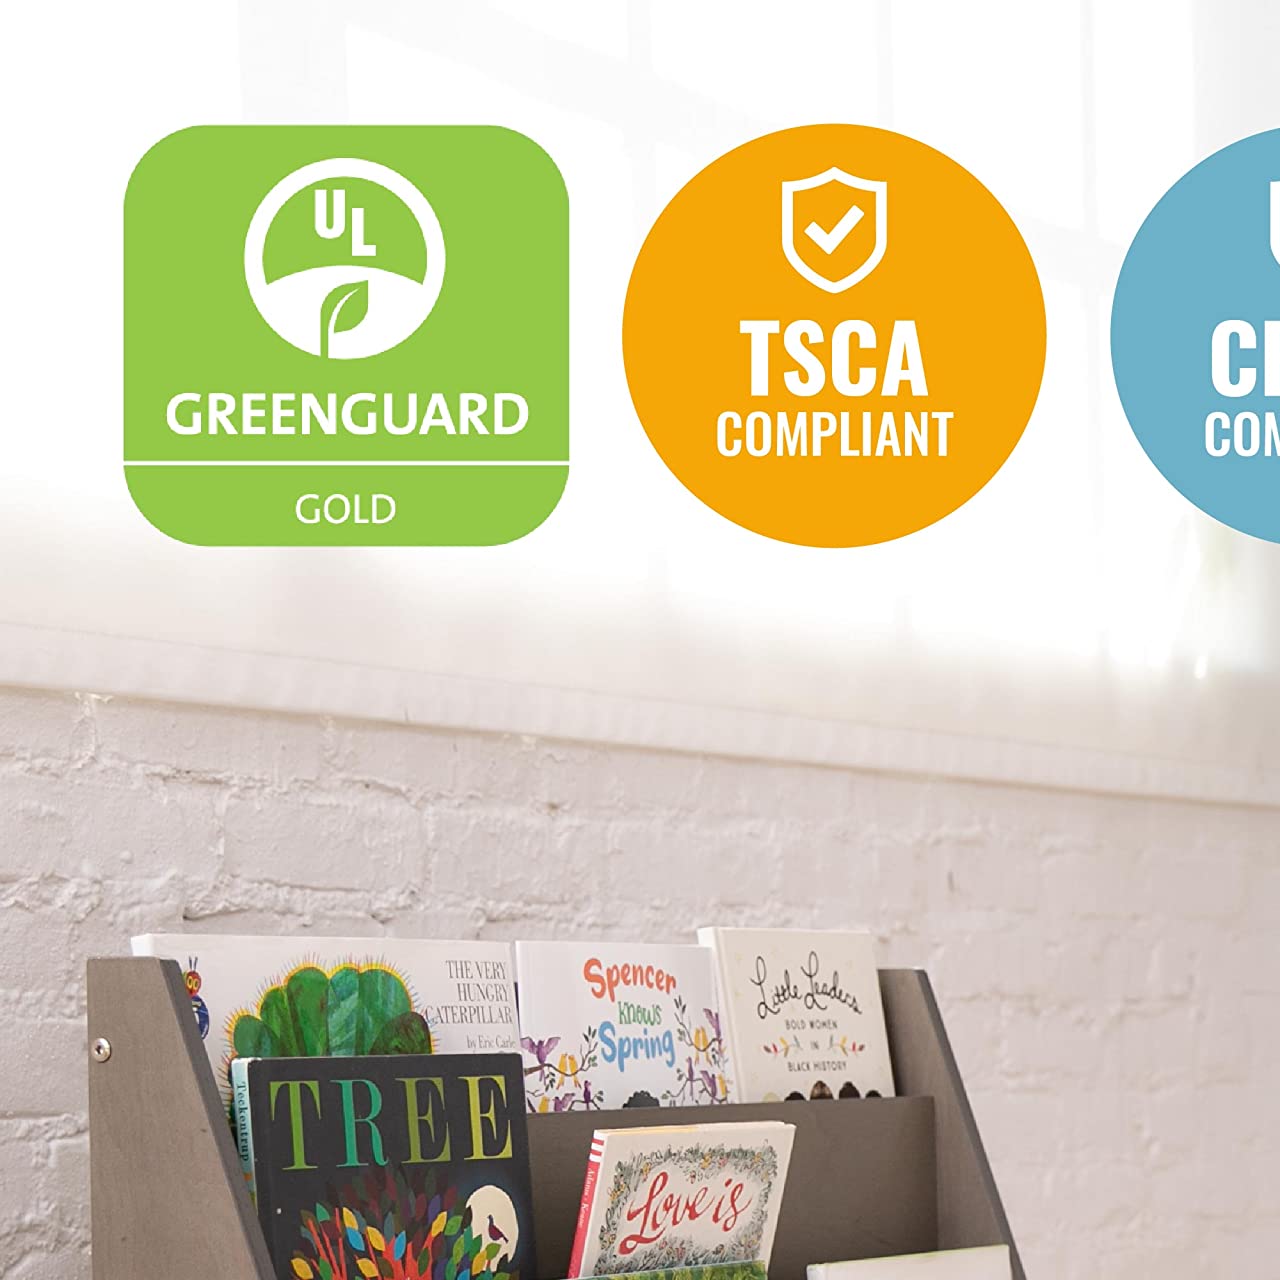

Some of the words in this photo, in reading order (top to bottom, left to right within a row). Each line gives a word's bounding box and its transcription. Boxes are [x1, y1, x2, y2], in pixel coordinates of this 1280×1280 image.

[446, 960, 473, 978] THE
[475, 961, 506, 980] VERY
[583, 958, 676, 1003] Spencer
[749, 955, 802, 1019] Little
[800, 950, 862, 1015] Leaders
[457, 983, 508, 1002] HUNGRY
[426, 1005, 513, 1024] CATERPILLAR
[786, 1020, 806, 1030] BOLD
[810, 1020, 838, 1030] WOMEN
[466, 1035, 477, 1051] by
[478, 1035, 494, 1048] Eric
[496, 1035, 516, 1048] Carle
[598, 1021, 676, 1072] Spring
[788, 1062, 810, 1072] BLACK
[814, 1061, 846, 1072] HISTORY
[236, 1082, 250, 1162] Teckentrup
[269, 1074, 513, 1170] TREE
[618, 1171, 715, 1254] Love
[712, 1178, 752, 1232] is
